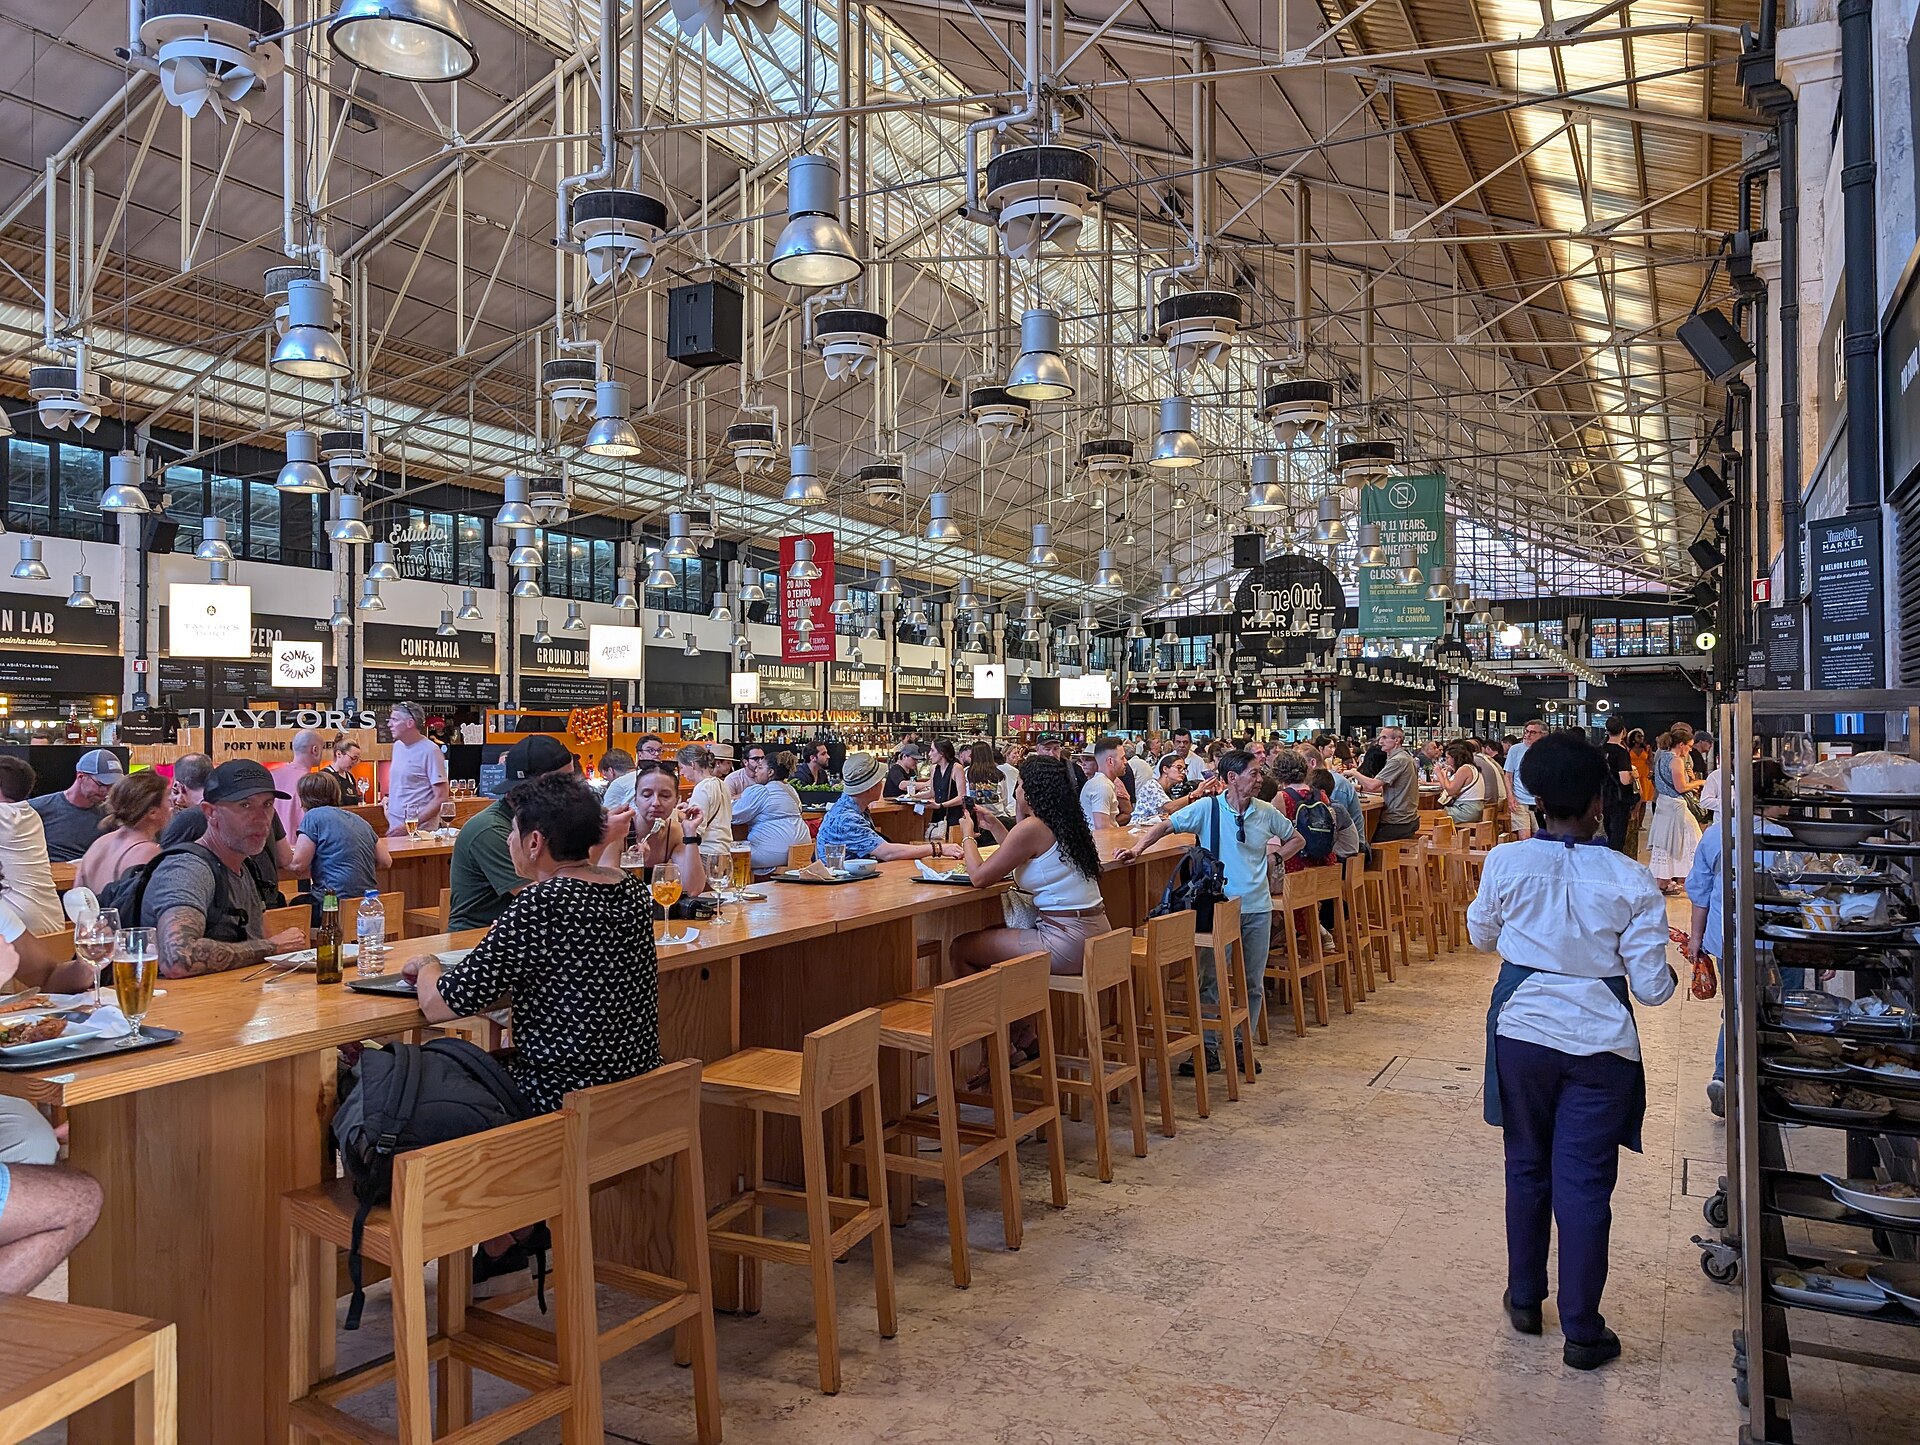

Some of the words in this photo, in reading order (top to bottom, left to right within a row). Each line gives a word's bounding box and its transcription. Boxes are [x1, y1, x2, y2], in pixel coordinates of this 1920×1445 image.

[1389, 521, 1397, 531] 11
[1399, 519, 1428, 531] YEARS,
[1380, 532, 1396, 543] E'VE
[1398, 531, 1437, 543] INSPIRED
[1826, 530, 1844, 542] Time
[1843, 527, 1857, 540] Out
[1822, 538, 1863, 551] MARKET
[1824, 562, 1843, 571] MELHOR
[1850, 558, 1867, 567] LISBOA
[1370, 569, 1400, 580] GLASS
[786, 581, 794, 589] 20
[1250, 583, 1290, 611] Tme
[1290, 582, 1322, 611] Out
[787, 600, 795, 608] DE
[1407, 606, 1425, 614] TEMPO
[21, 610, 54, 634] LAB
[1271, 630, 1305, 638] LISBOA
[1823, 635, 1832, 643] THE
[1833, 634, 1844, 642] BEST
[1845, 633, 1852, 641] OF
[1852, 632, 1870, 640] LISBON
[0, 637, 26, 645] ozinha
[401, 638, 460, 659] CONFRARIA
[280, 649, 314, 663] FUNKY
[536, 647, 571, 665] GROUND
[279, 663, 316, 680] CHUNKY
[190, 708, 377, 734] TAYLOR'S
[781, 710, 810, 722] CASA
[811, 710, 824, 722] DE
[826, 710, 861, 722] VINHOS
[224, 742, 253, 751] PORT
[257, 742, 286, 750] WINE
